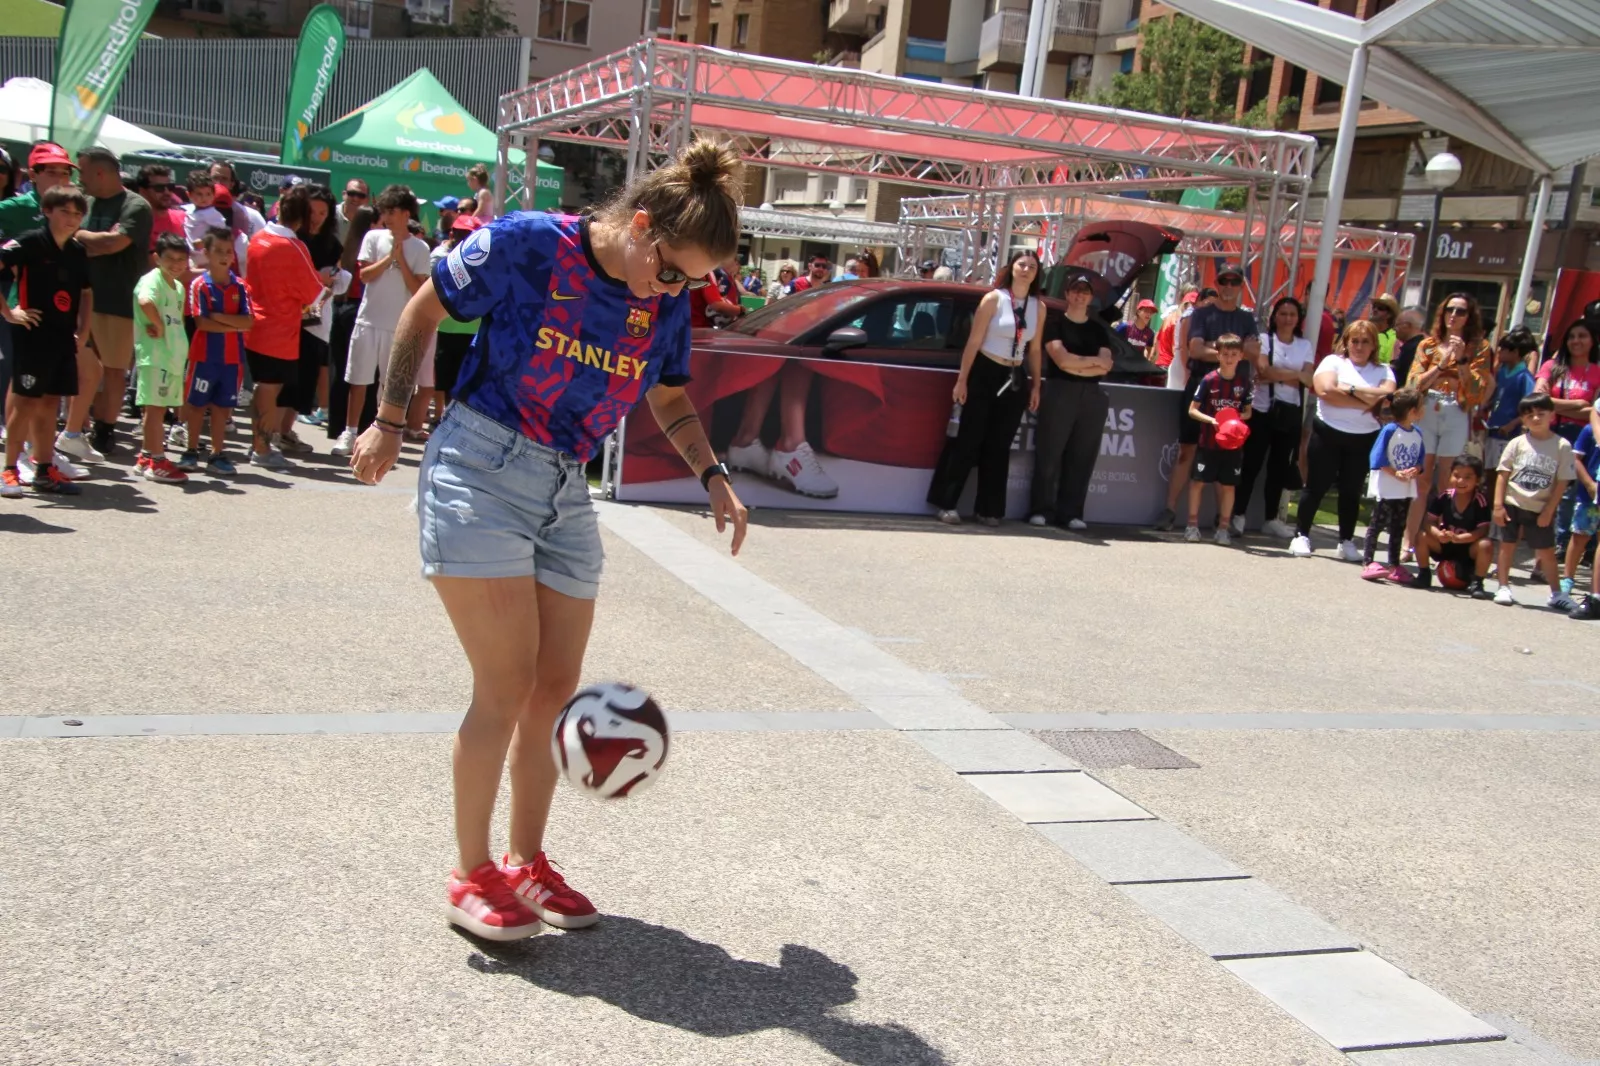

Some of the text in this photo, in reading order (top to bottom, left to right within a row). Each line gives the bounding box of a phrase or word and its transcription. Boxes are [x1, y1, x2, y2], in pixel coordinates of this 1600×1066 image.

[84, 0, 142, 89] Iberdrol
[302, 35, 337, 125] Iberdrola
[395, 136, 474, 155] Iberdrola
[332, 150, 388, 168] Iberdrola
[422, 160, 469, 177] Iberdrol
[508, 171, 560, 189] Iberola
[1435, 233, 1473, 259] Bar
[535, 327, 648, 380] STANLEY
[195, 377, 209, 393] 10
